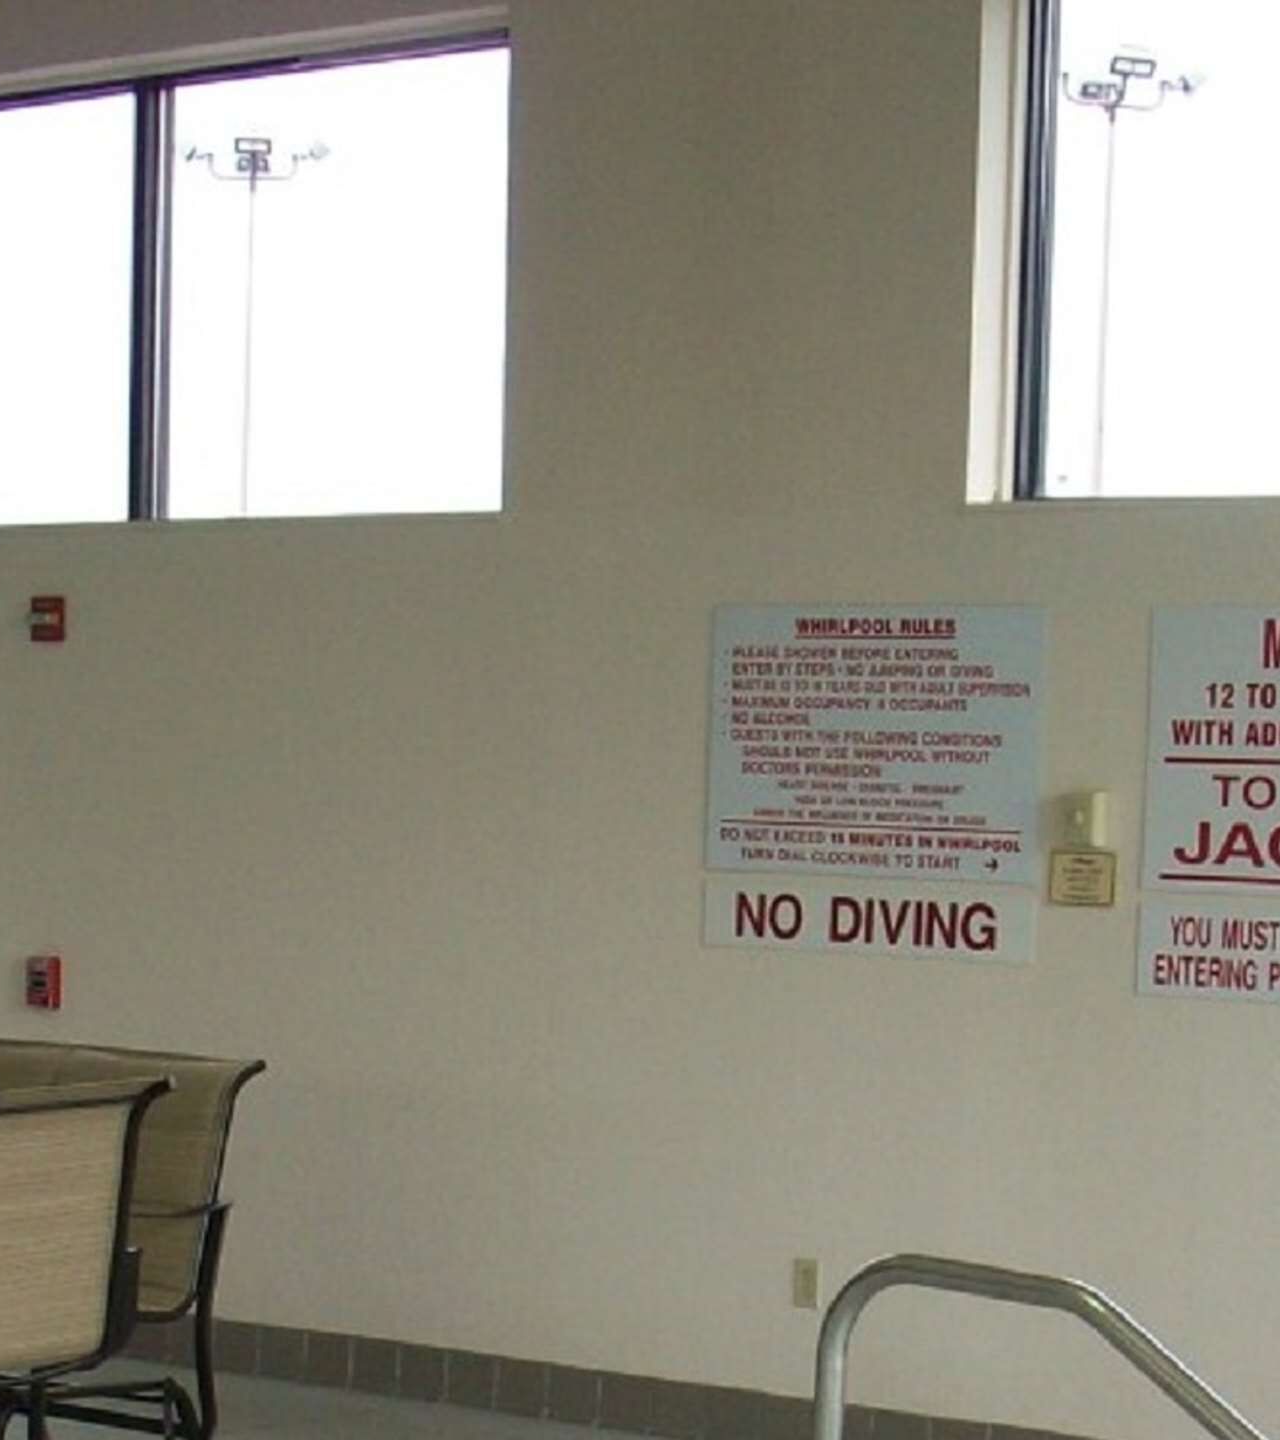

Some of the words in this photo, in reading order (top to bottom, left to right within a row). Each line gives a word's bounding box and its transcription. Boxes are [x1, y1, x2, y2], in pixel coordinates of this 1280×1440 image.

[795, 617, 893, 635] WHIRLPOOL
[900, 618, 956, 635] RULES
[783, 647, 837, 660] SHOWER
[840, 648, 891, 661] BEFORE
[894, 648, 959, 661] ENTERING
[731, 662, 772, 676] ENTER
[776, 662, 792, 677] BY
[795, 662, 835, 677] STEPS
[846, 662, 864, 677] NO
[868, 663, 923, 678] JUMPING
[927, 664, 946, 678] OR
[949, 665, 994, 679] DIVING
[958, 683, 1031, 697] SUPERVISION
[1205, 682, 1234, 709] 12
[1246, 683, 1277, 710] TO
[731, 695, 790, 709] MAXIMUM
[793, 696, 871, 710] OCCUPANCY
[889, 698, 968, 712] OCCUPANTS
[731, 710, 748, 725] NO
[752, 711, 810, 726] ALCOHOL
[730, 729, 779, 742] GUESTS
[781, 729, 813, 742] WITH
[843, 730, 918, 745] FOLLOWING
[921, 731, 1003, 748] CONDITIONS
[1171, 719, 1234, 746] WITH
[741, 745, 792, 758] SHOULD
[794, 746, 821, 758] NOT
[825, 747, 849, 759] USE
[852, 748, 927, 762] WHIRLPOOL
[931, 749, 990, 764] WITHOUT
[804, 762, 881, 778] PERMISSION
[1212, 774, 1277, 810] TO
[720, 826, 741, 842] DO
[743, 827, 770, 843] NOT
[773, 829, 827, 845] EXCEED
[848, 832, 914, 848] MINUTES
[917, 835, 933, 848] IN
[936, 836, 1022, 854] WHIRLPOOL
[740, 846, 775, 861] TURN
[777, 848, 807, 862] DIAL
[810, 849, 889, 868] CLOCKWISE
[895, 854, 913, 869] TO
[917, 855, 960, 870] START
[734, 891, 803, 941] NO
[829, 896, 998, 952] DIVING
[1170, 916, 1212, 948] YOU
[1152, 953, 1259, 992] ENTERING
